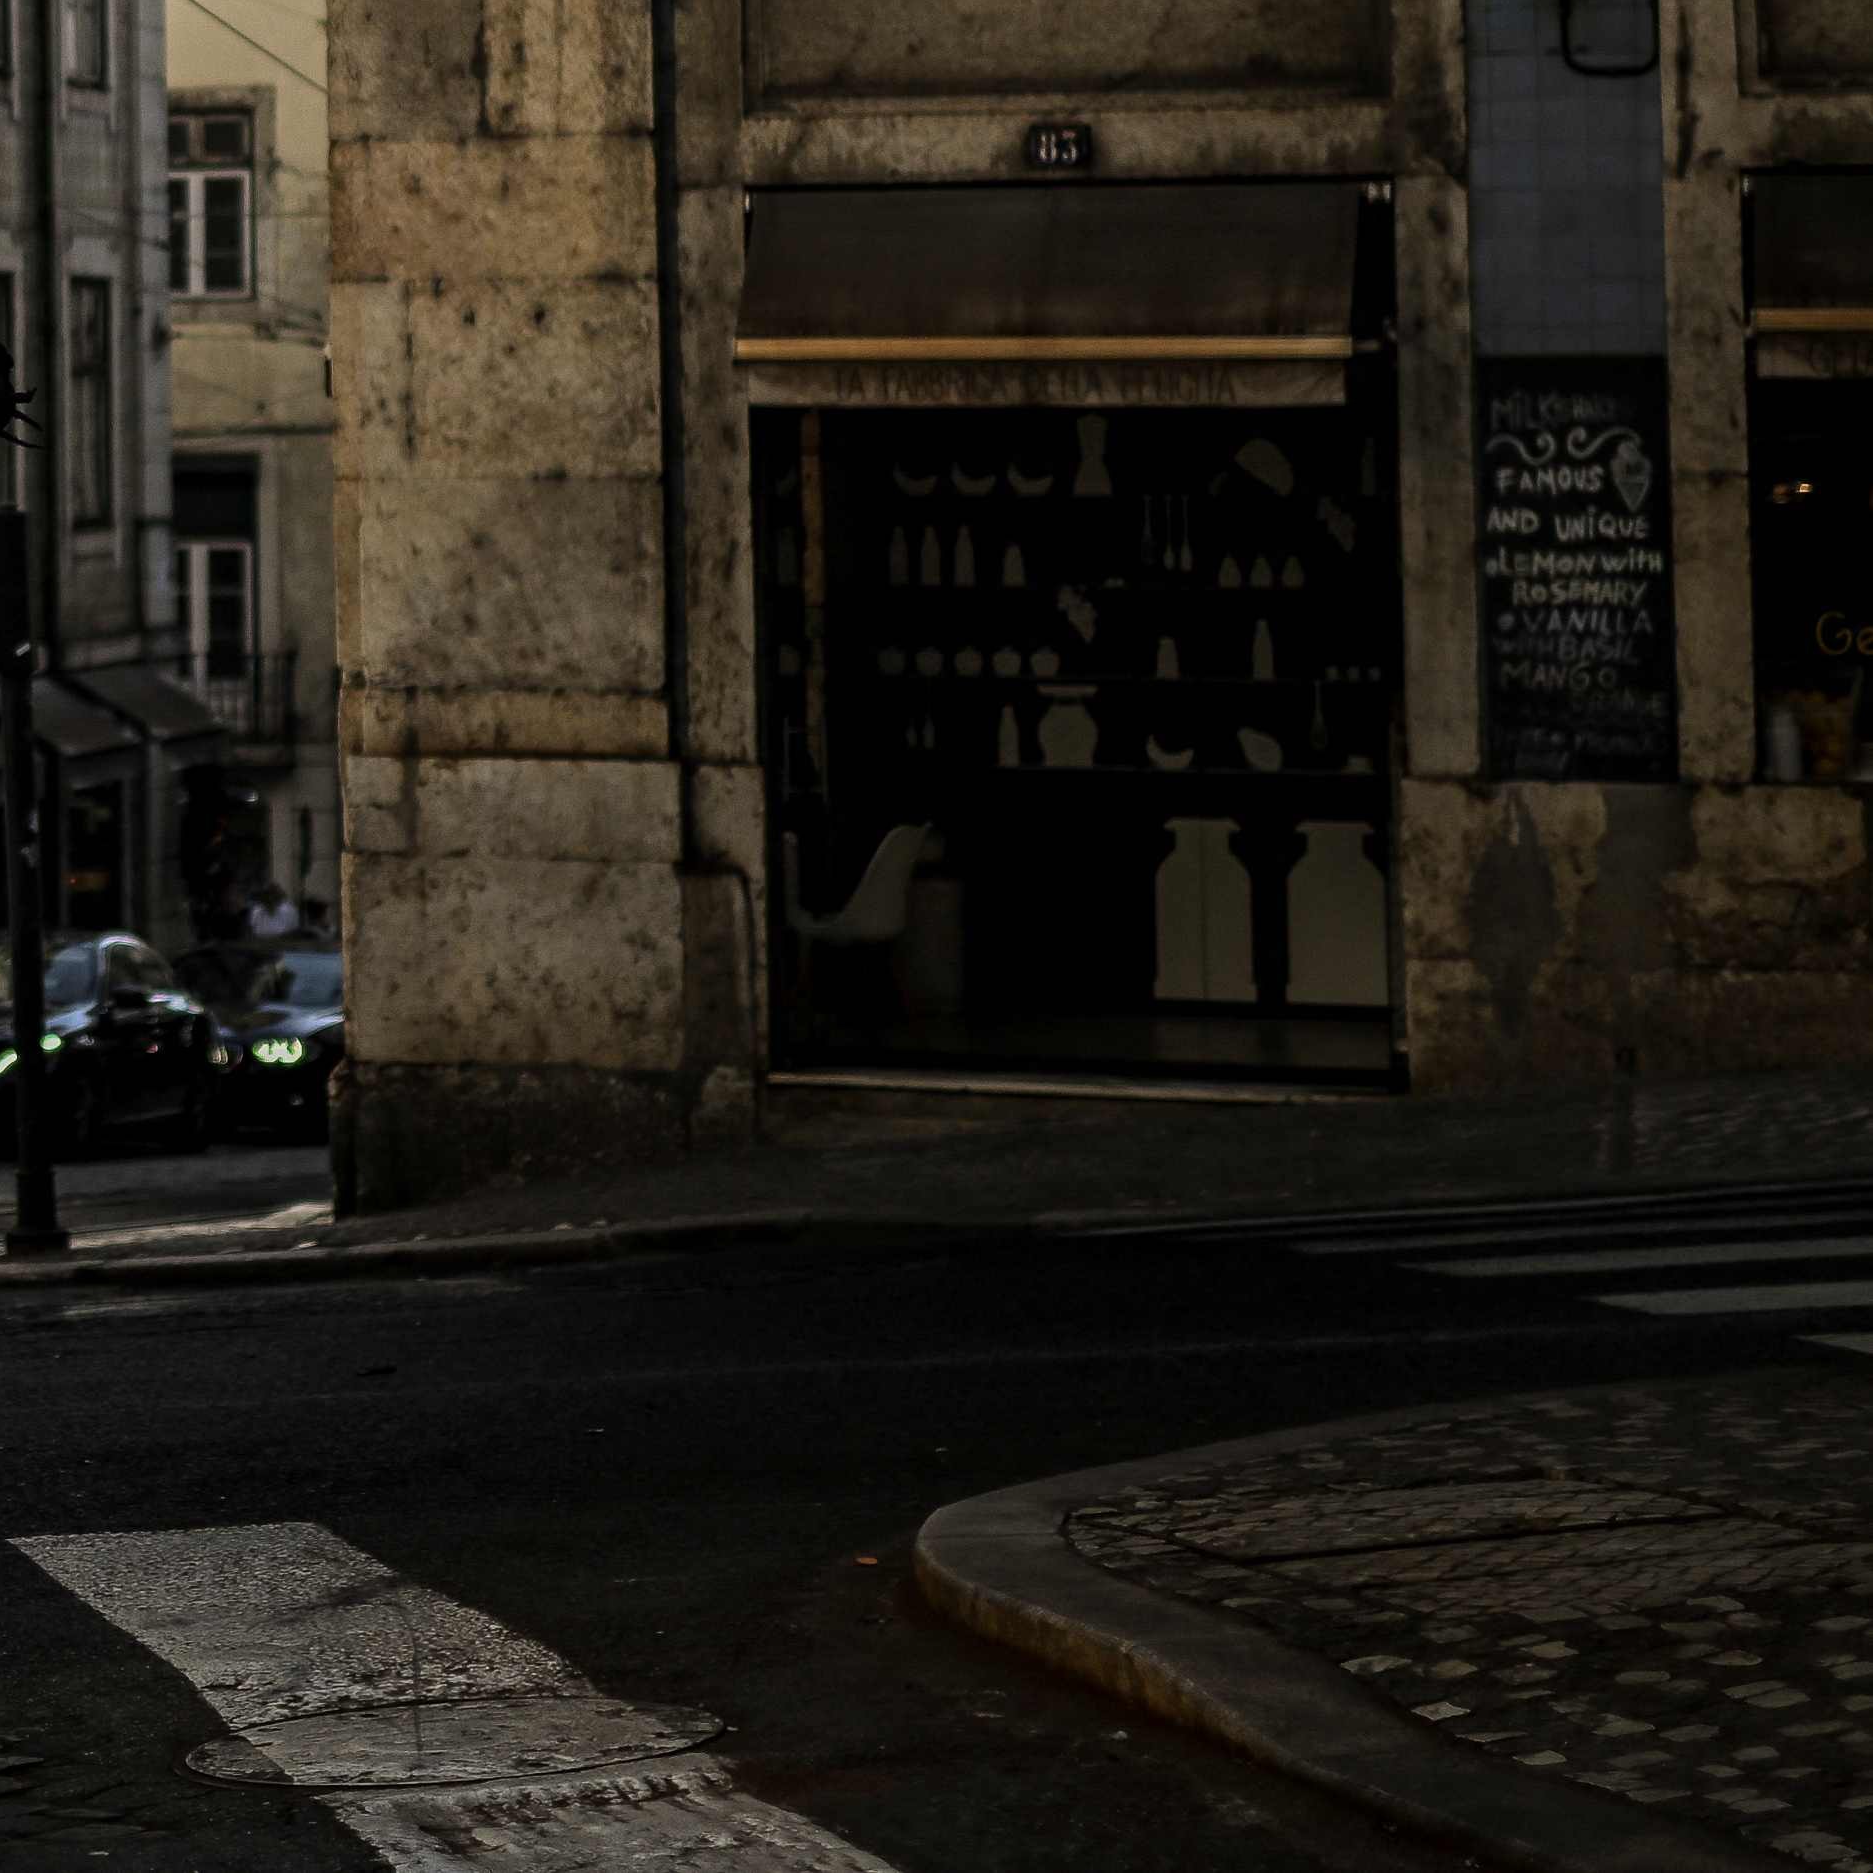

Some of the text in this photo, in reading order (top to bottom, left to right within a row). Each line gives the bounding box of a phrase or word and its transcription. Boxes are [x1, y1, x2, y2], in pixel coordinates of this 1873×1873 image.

[1496, 465, 1604, 497] FAMOUS
[1486, 505, 1541, 535] AND
[1522, 607, 1654, 635] VANILLA
